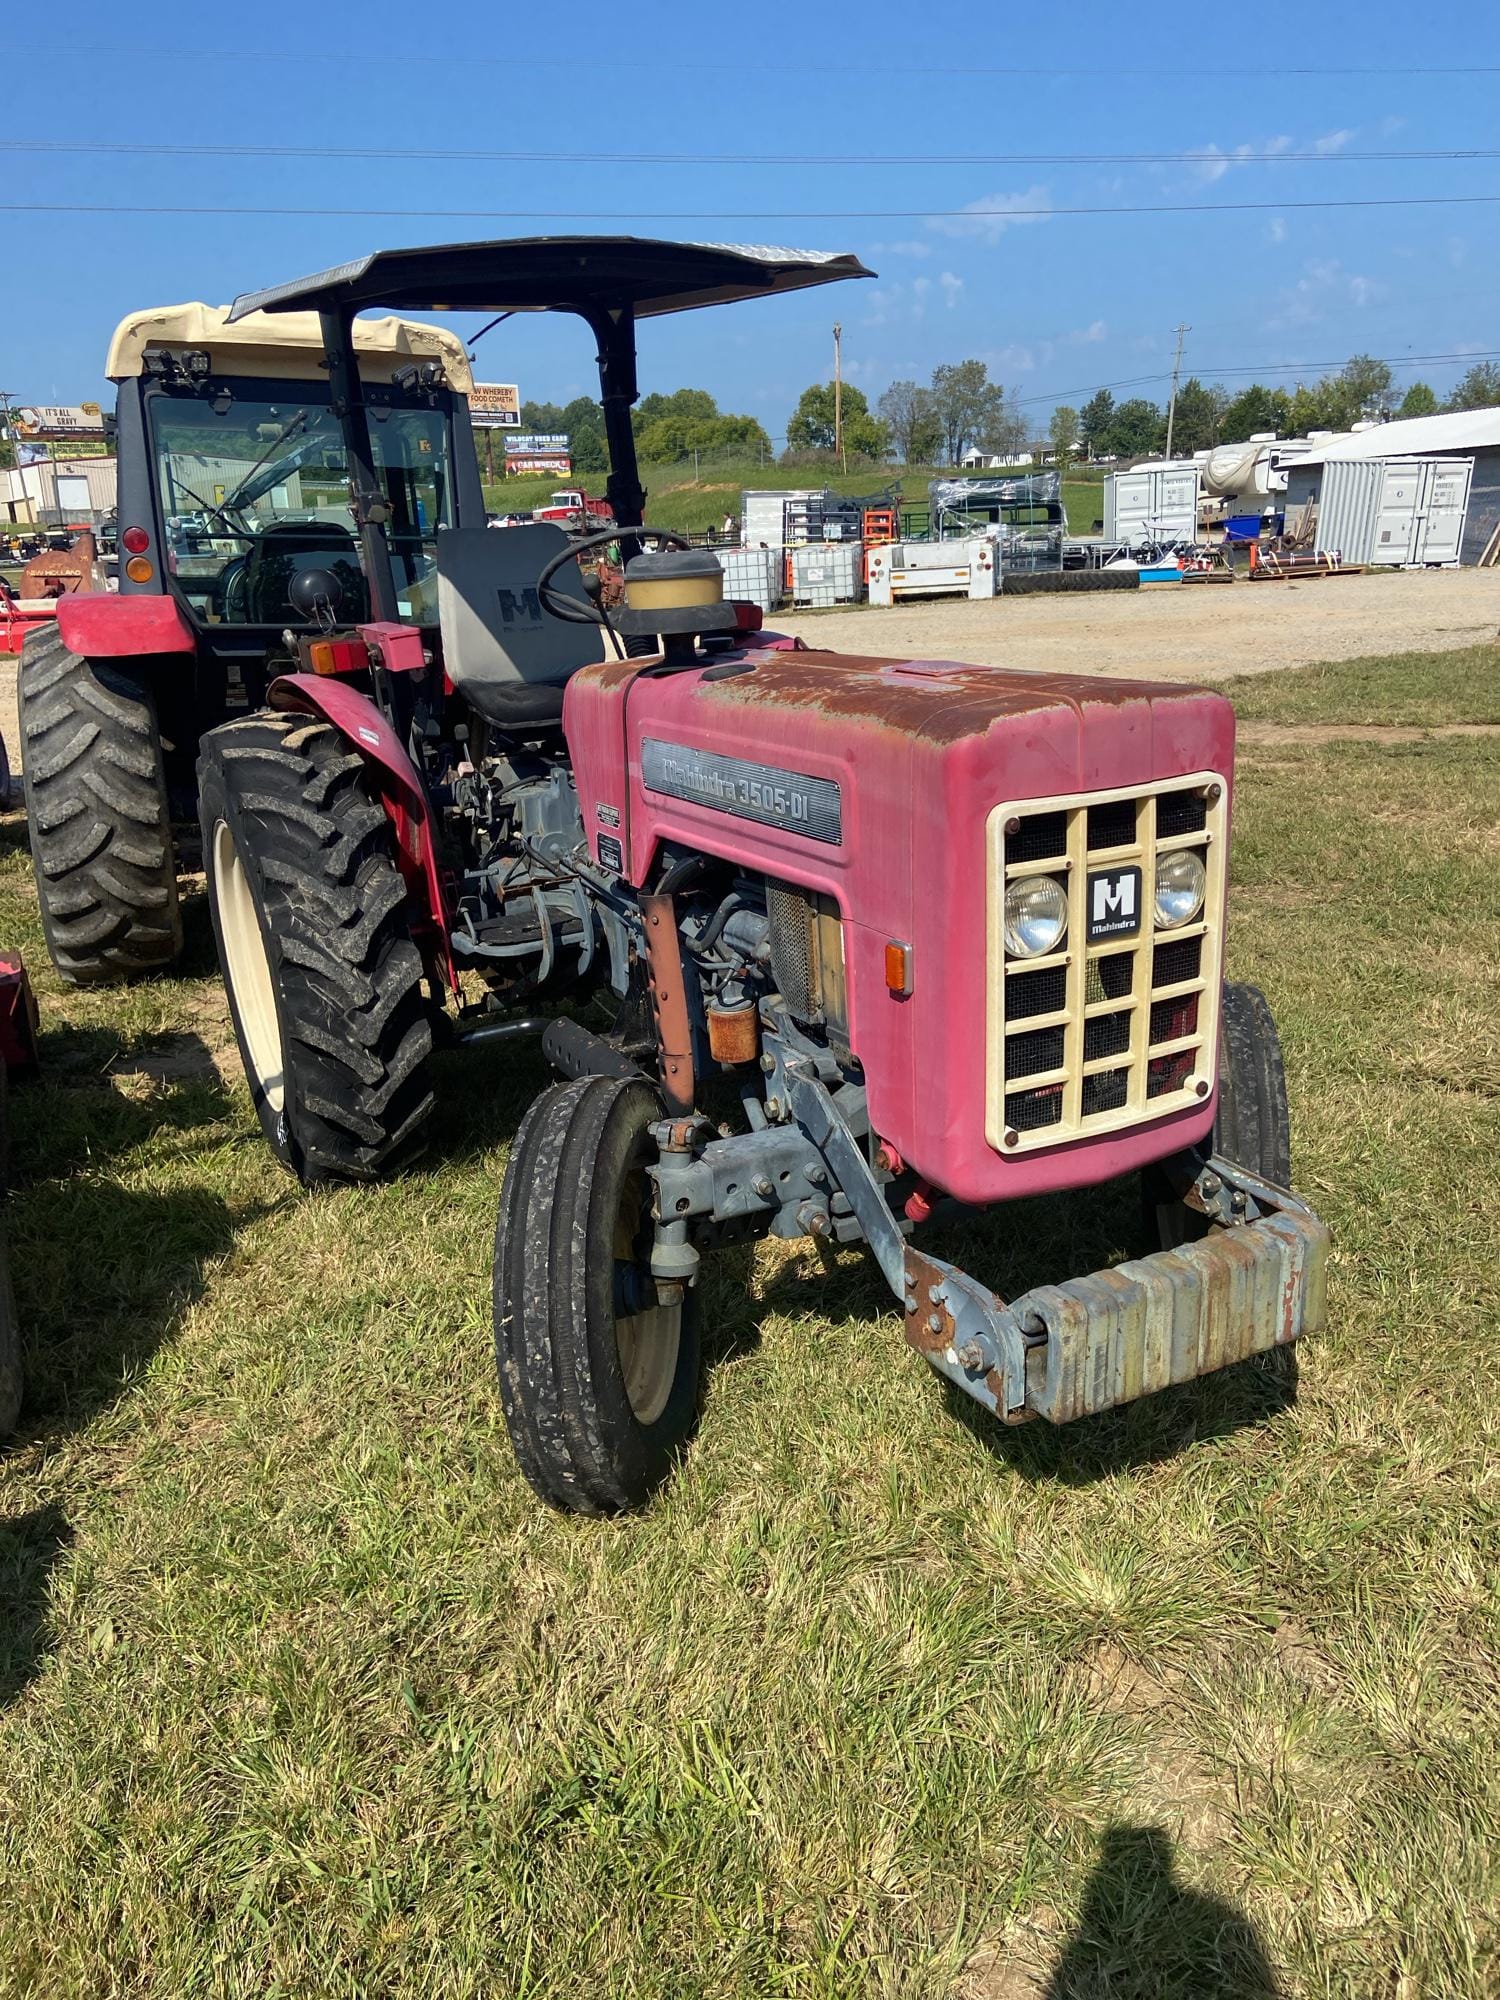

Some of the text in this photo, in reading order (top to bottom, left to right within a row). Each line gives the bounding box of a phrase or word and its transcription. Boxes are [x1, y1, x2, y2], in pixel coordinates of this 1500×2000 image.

[483, 387, 513, 396] WHEREBY
[517, 460, 533, 469] CAR
[662, 758, 736, 800] Mahindra
[1092, 920, 1136, 934] Mahindra
